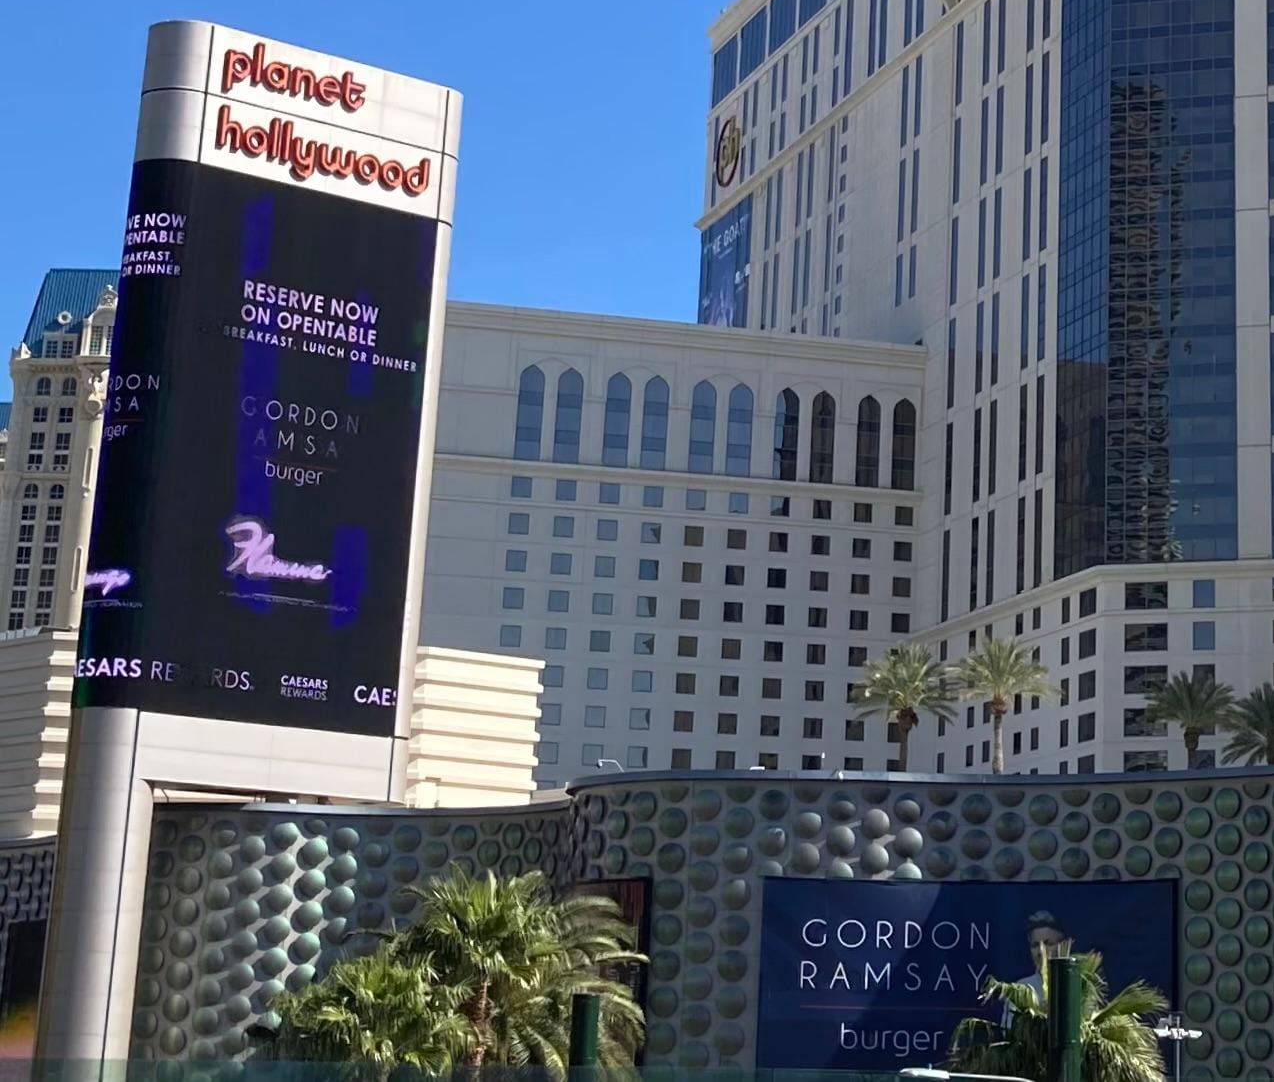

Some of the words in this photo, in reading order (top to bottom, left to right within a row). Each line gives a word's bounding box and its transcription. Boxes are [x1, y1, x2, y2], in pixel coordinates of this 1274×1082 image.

[220, 42, 366, 112] planet
[215, 105, 431, 197] hollywood
[144, 212, 186, 228] NOW
[135, 263, 181, 276] DINNER
[244, 280, 325, 314] RESERVE
[330, 298, 379, 325] NOW
[241, 304, 271, 326] ON
[276, 311, 378, 346] OPENTABLE
[303, 340, 346, 359] LUNCH
[350, 350, 367, 364] OR
[372, 354, 418, 372] DINNER
[241, 396, 359, 435] GORDON
[265, 460, 323, 487] burger
[75, 657, 142, 678] ESARS
[280, 675, 329, 691] CAESARS
[280, 686, 327, 701] REWARDS
[802, 918, 990, 950] GORDON
[799, 960, 988, 992] RAMSAY
[840, 1022, 944, 1058] burger
